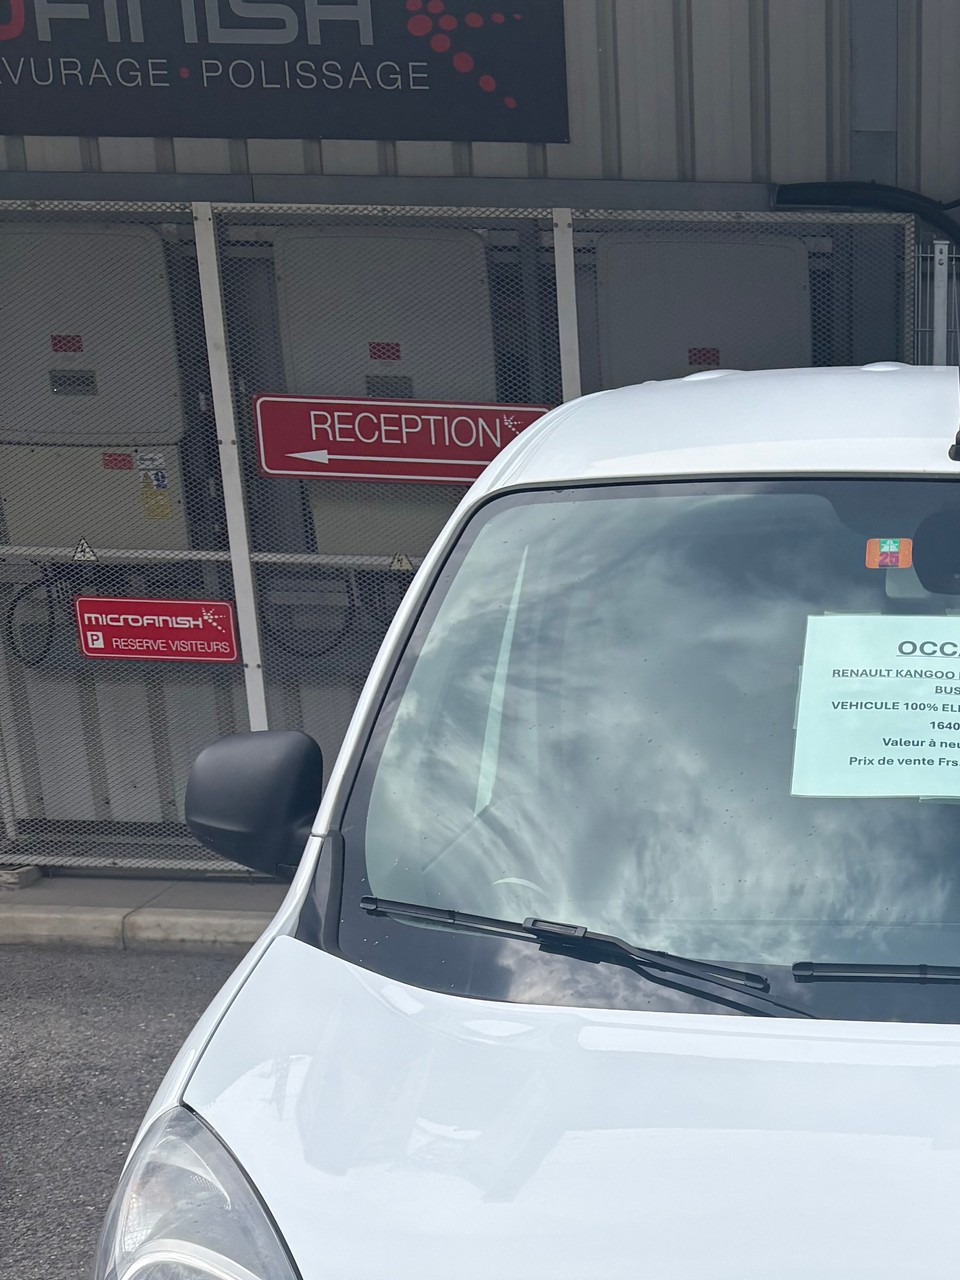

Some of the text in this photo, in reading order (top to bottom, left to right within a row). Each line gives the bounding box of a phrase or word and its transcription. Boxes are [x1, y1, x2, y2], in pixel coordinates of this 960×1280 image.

[0, 0, 374, 45] FINISH
[0, 57, 430, 90] VURAGE POLISSAGE
[310, 411, 501, 447] RECEPTION
[84, 613, 203, 629] MICROFINISH
[112, 638, 167, 651] RESERVE
[169, 641, 230, 653] VISITEURS
[832, 669, 893, 678] RENAULT
[895, 669, 956, 680] KANGOO
[831, 701, 900, 710] VEHICULE
[903, 702, 939, 712] 100%
[882, 738, 926, 747] Valeur
[928, 738, 937, 748] à
[849, 756, 875, 766] Prix
[877, 756, 895, 766] de
[897, 757, 935, 766] vente
